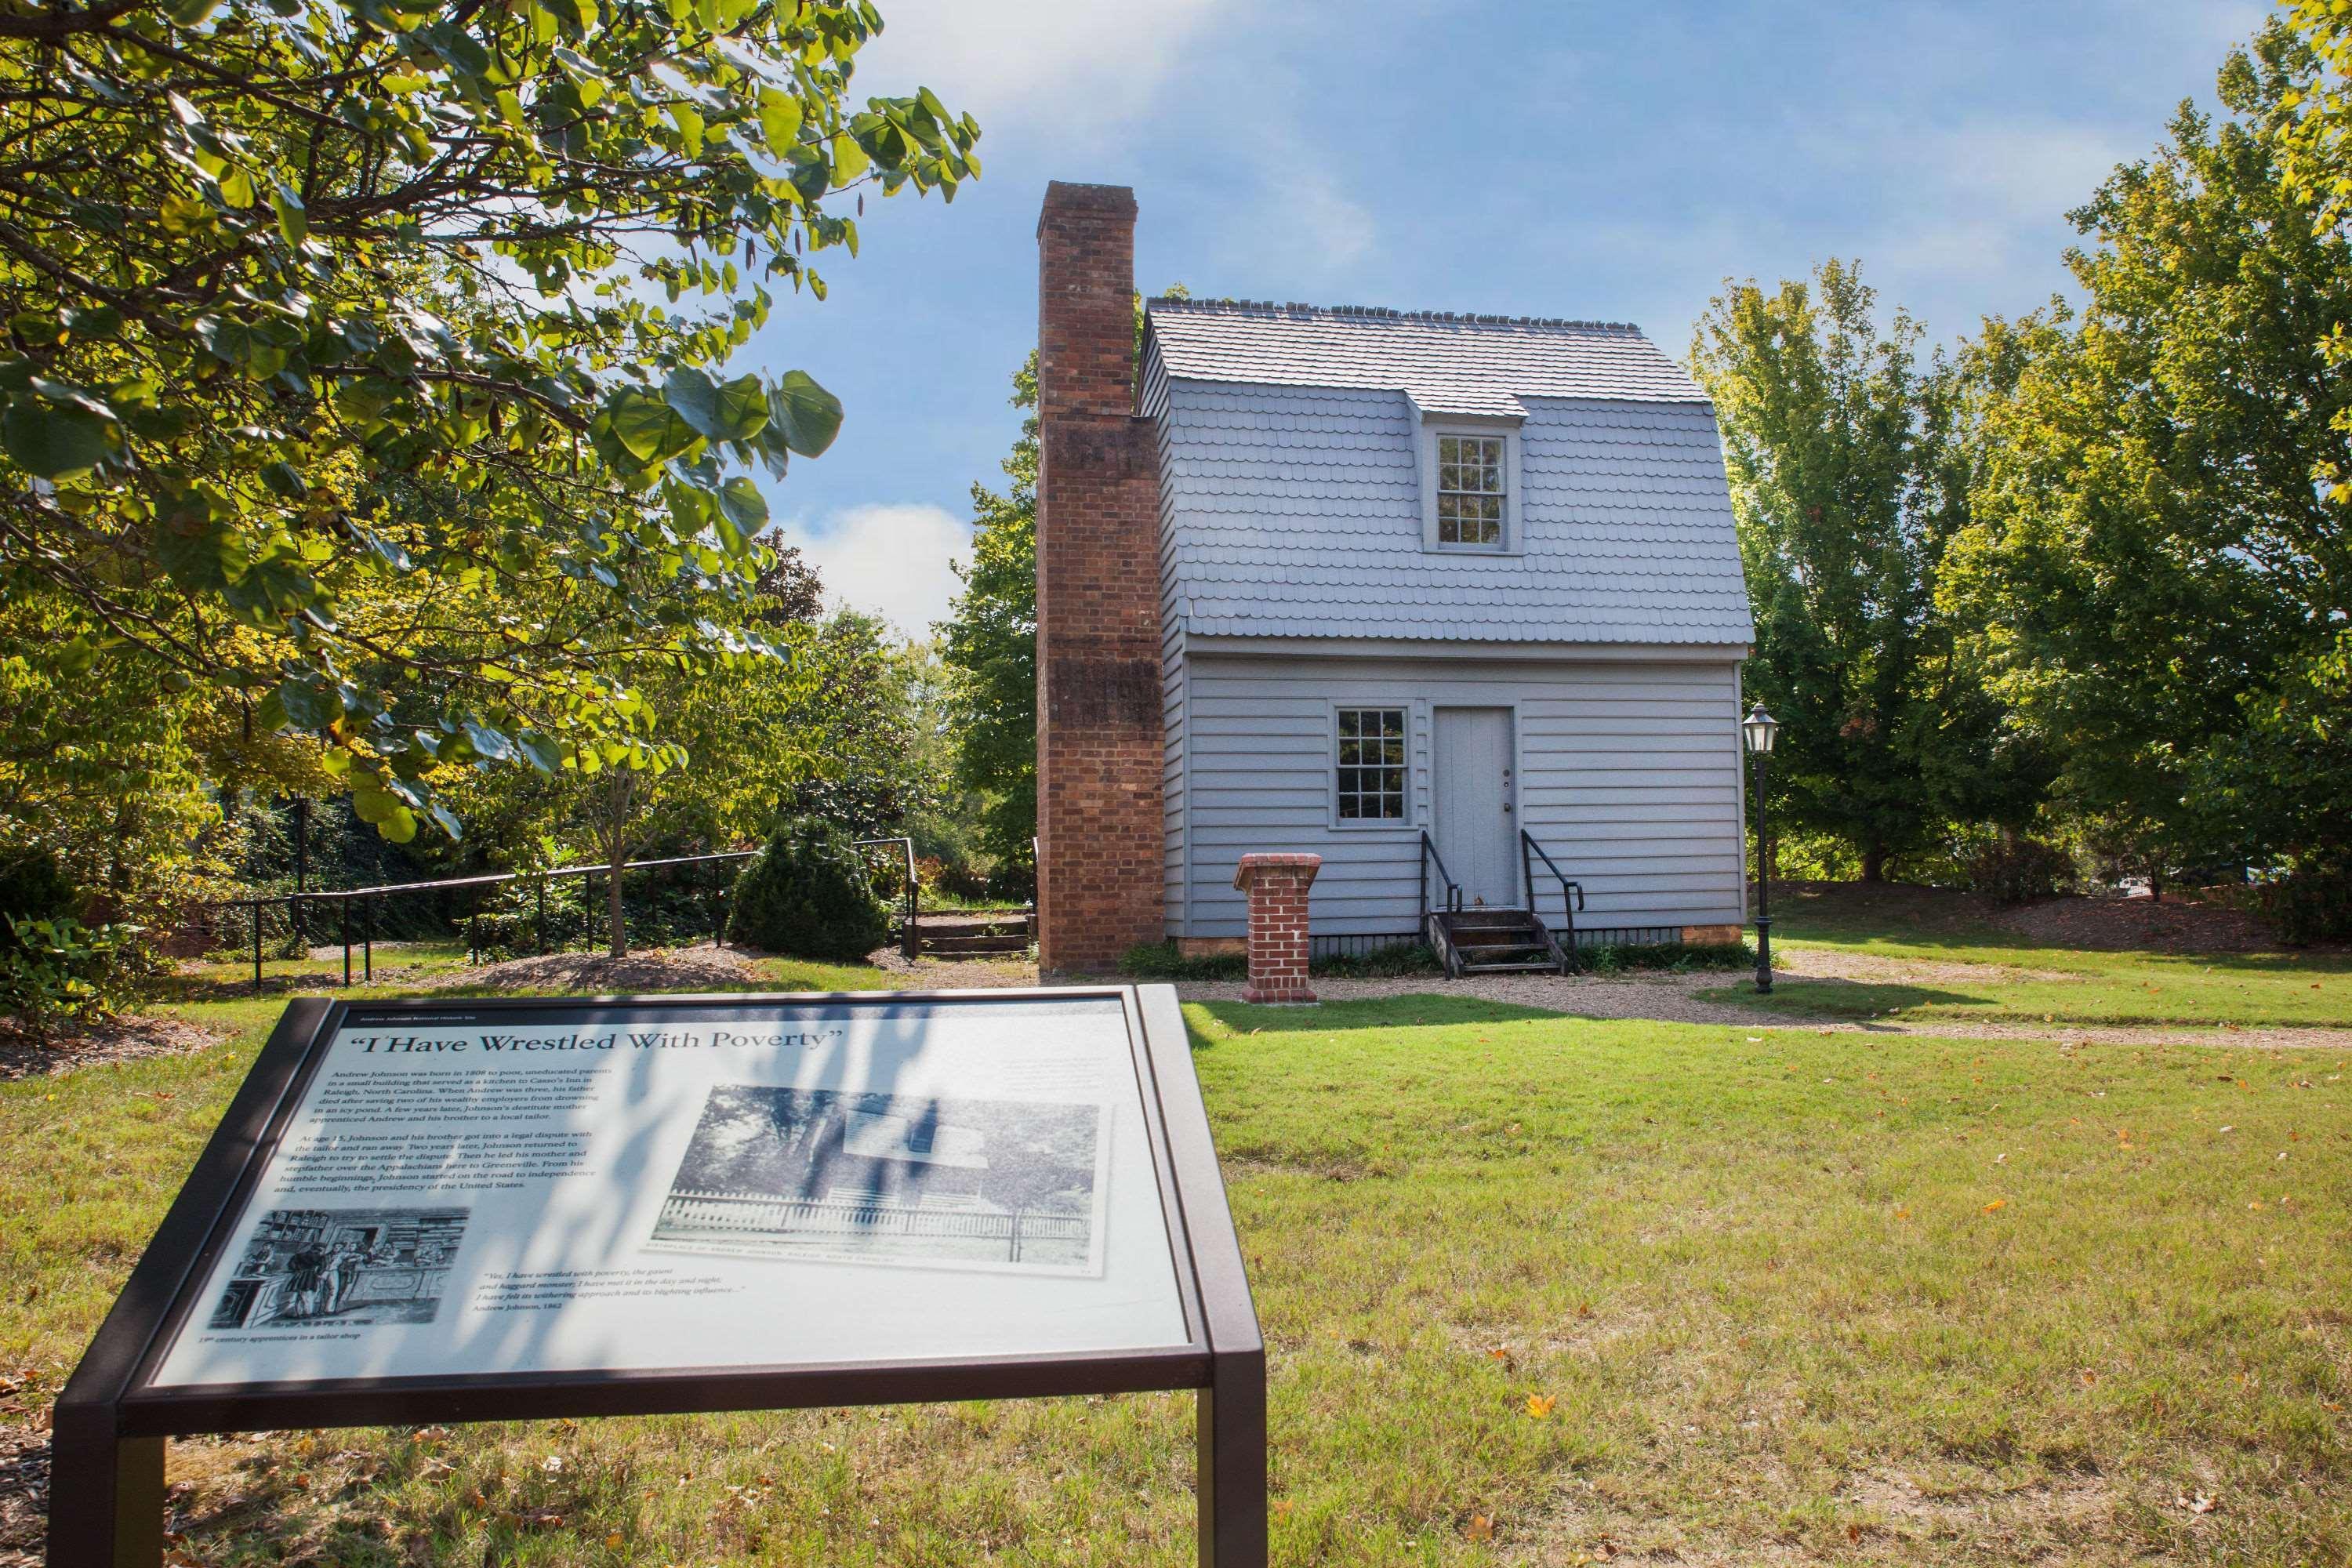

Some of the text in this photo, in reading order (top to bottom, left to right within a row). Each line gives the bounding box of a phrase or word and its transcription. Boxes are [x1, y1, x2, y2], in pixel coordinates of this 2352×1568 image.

[351, 1030, 843, 1052] “I Have Wrestled With Poverty”
[372, 1185, 425, 1193] presidency
